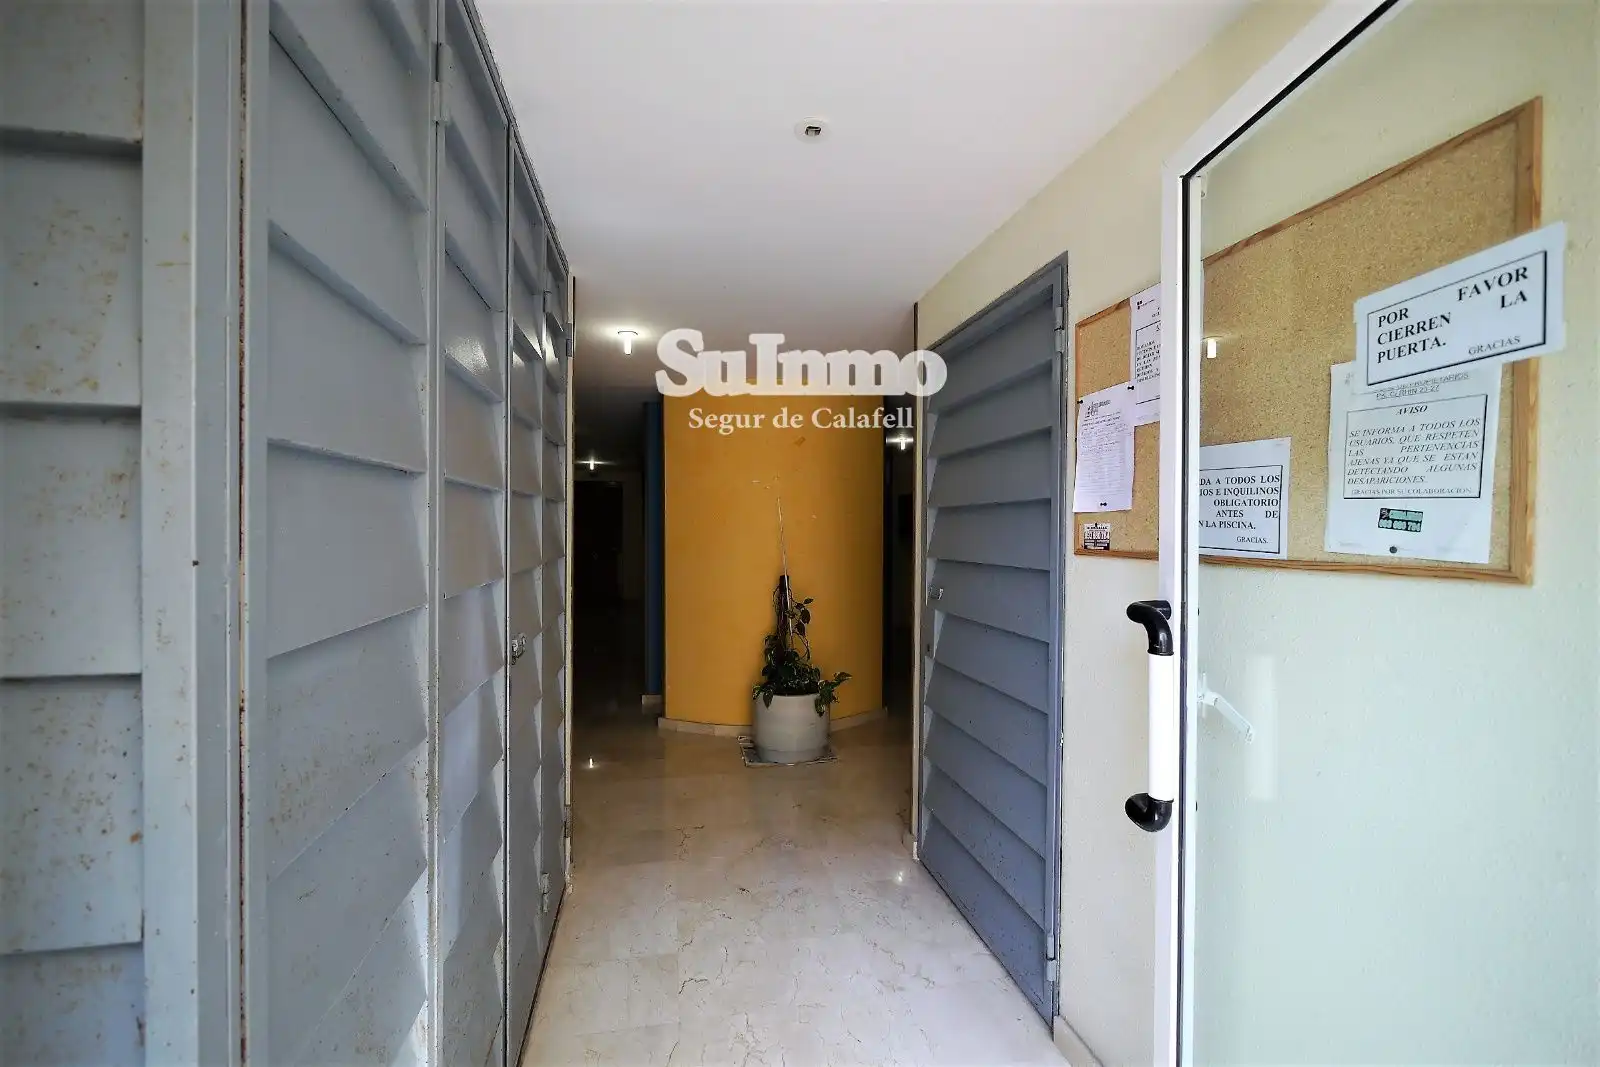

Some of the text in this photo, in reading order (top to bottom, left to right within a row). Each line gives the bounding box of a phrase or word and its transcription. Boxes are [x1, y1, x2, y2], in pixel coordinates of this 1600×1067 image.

[1377, 266, 1528, 327] POR FAVOR
[1377, 290, 1528, 345] CIERREN LA
[1377, 335, 1521, 363] PUERTA. GRACIAS
[1397, 405, 1428, 415] AVISO
[1363, 426, 1405, 437] INFORMA
[1419, 420, 1456, 431] TODOS
[1459, 418, 1481, 427] LOS
[1400, 434, 1420, 444] QUE
[1426, 430, 1479, 440] RESPETEN
[1348, 440, 1480, 457] LAS PERTENENCIAS
[1347, 457, 1380, 466] AJENAS
[1398, 455, 1420, 464] QUE
[1422, 453, 1437, 462] SE
[1347, 464, 1477, 476] DETECTANDO ALGUNAS
[1199, 478, 1211, 486] DA
[1225, 476, 1256, 485] TODOS
[1260, 475, 1280, 483] LOS
[1224, 487, 1279, 496] INQUILINOS
[1265, 510, 1278, 518] DE
[1219, 521, 1256, 529] PISCINA.
[1236, 536, 1269, 544] GRACIAS.
